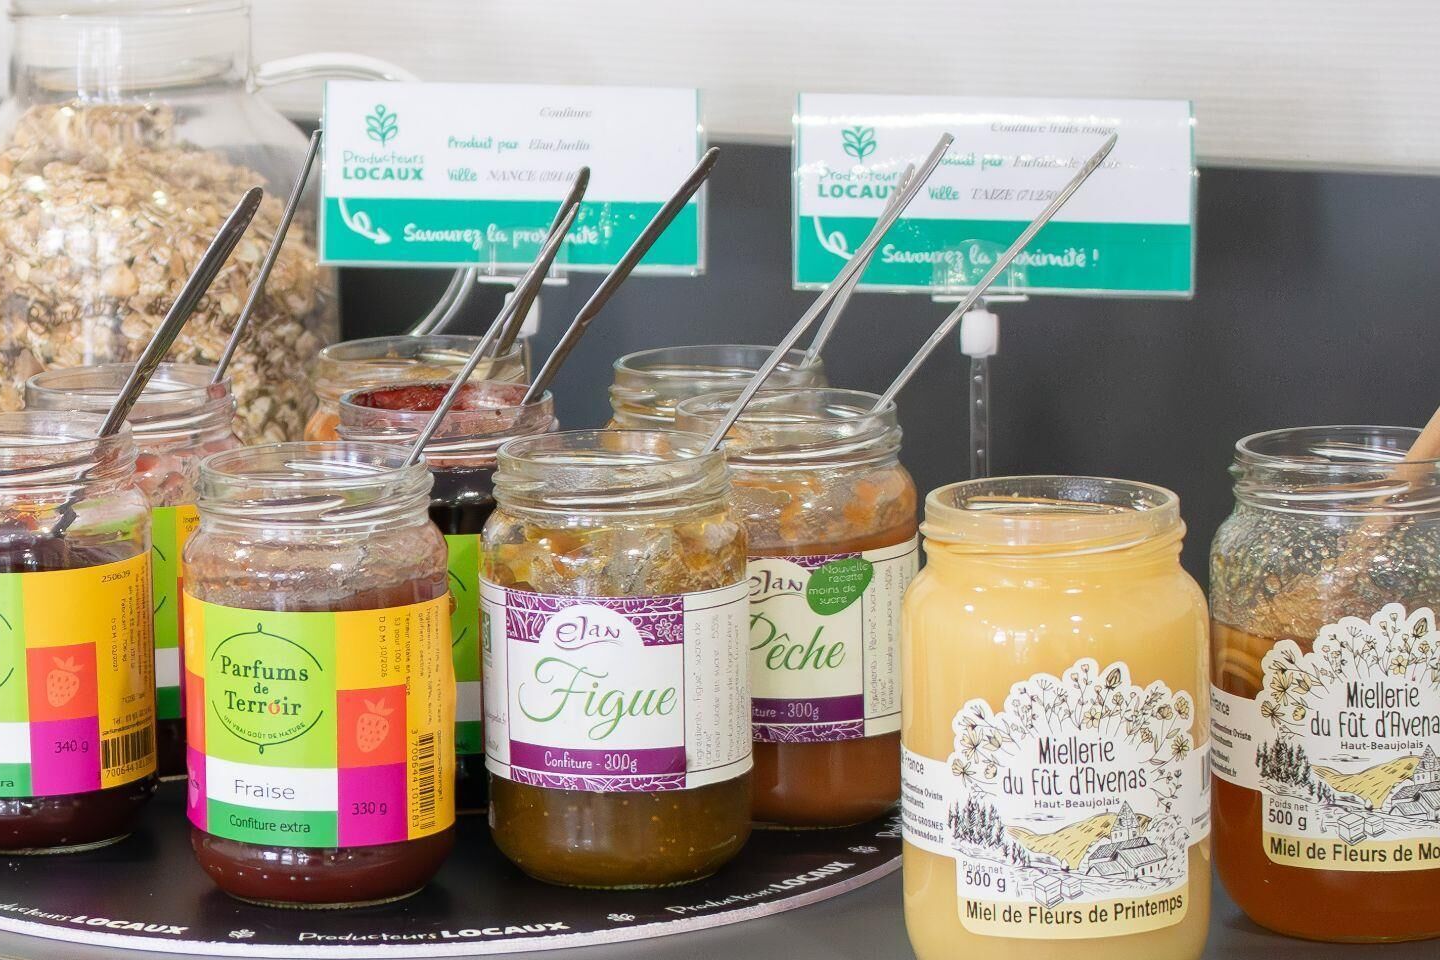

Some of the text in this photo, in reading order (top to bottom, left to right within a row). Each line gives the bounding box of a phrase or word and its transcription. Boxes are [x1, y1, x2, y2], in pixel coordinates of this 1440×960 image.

[448, 136, 493, 149] Produit
[497, 140, 519, 154] par
[343, 150, 424, 164] Producteurs
[343, 166, 424, 181] LOCAUX
[448, 167, 478, 182] Ville
[928, 185, 960, 200] Ville
[403, 224, 481, 250] Savourez
[487, 225, 508, 244] la
[881, 243, 961, 272] Savourez
[969, 244, 991, 265] la
[808, 583, 857, 595] moins de
[819, 596, 848, 605] sucre
[220, 655, 309, 681] Parfums
[253, 682, 269, 694] de
[1346, 681, 1420, 709] Miellerie
[224, 690, 302, 716] Terroir
[517, 656, 678, 741] Figue
[751, 703, 820, 721] iture 300g
[247, 731, 266, 739] GOÛT
[279, 722, 306, 738] NATURE
[1310, 711, 1440, 739] du Fût d'Avena
[54, 741, 90, 754] 340 g
[1038, 737, 1116, 765] Miellerie
[1340, 741, 1424, 752] Haut-Beaujolais
[544, 751, 637, 773] Confiture 300g
[234, 780, 296, 801] Fraise
[1003, 766, 1148, 796] du Fût d'Avenas
[351, 803, 388, 815] 330 g
[1034, 796, 1121, 810] Haut-Beaujolais
[1269, 797, 1309, 812] Poids net
[229, 814, 311, 834] Confiture extra
[1268, 810, 1308, 831] 500 g
[1270, 836, 1440, 863] Miel de Fleurs de Mo
[962, 860, 1003, 875] Poids net
[665, 861, 856, 914] Producteurs LOCAUX
[966, 870, 1006, 893] 500 g
[965, 892, 1184, 925] Miel de Fleurs de Printemps
[70, 915, 190, 935] LOCAUX
[298, 921, 571, 943] Producteurs LOCAUX
